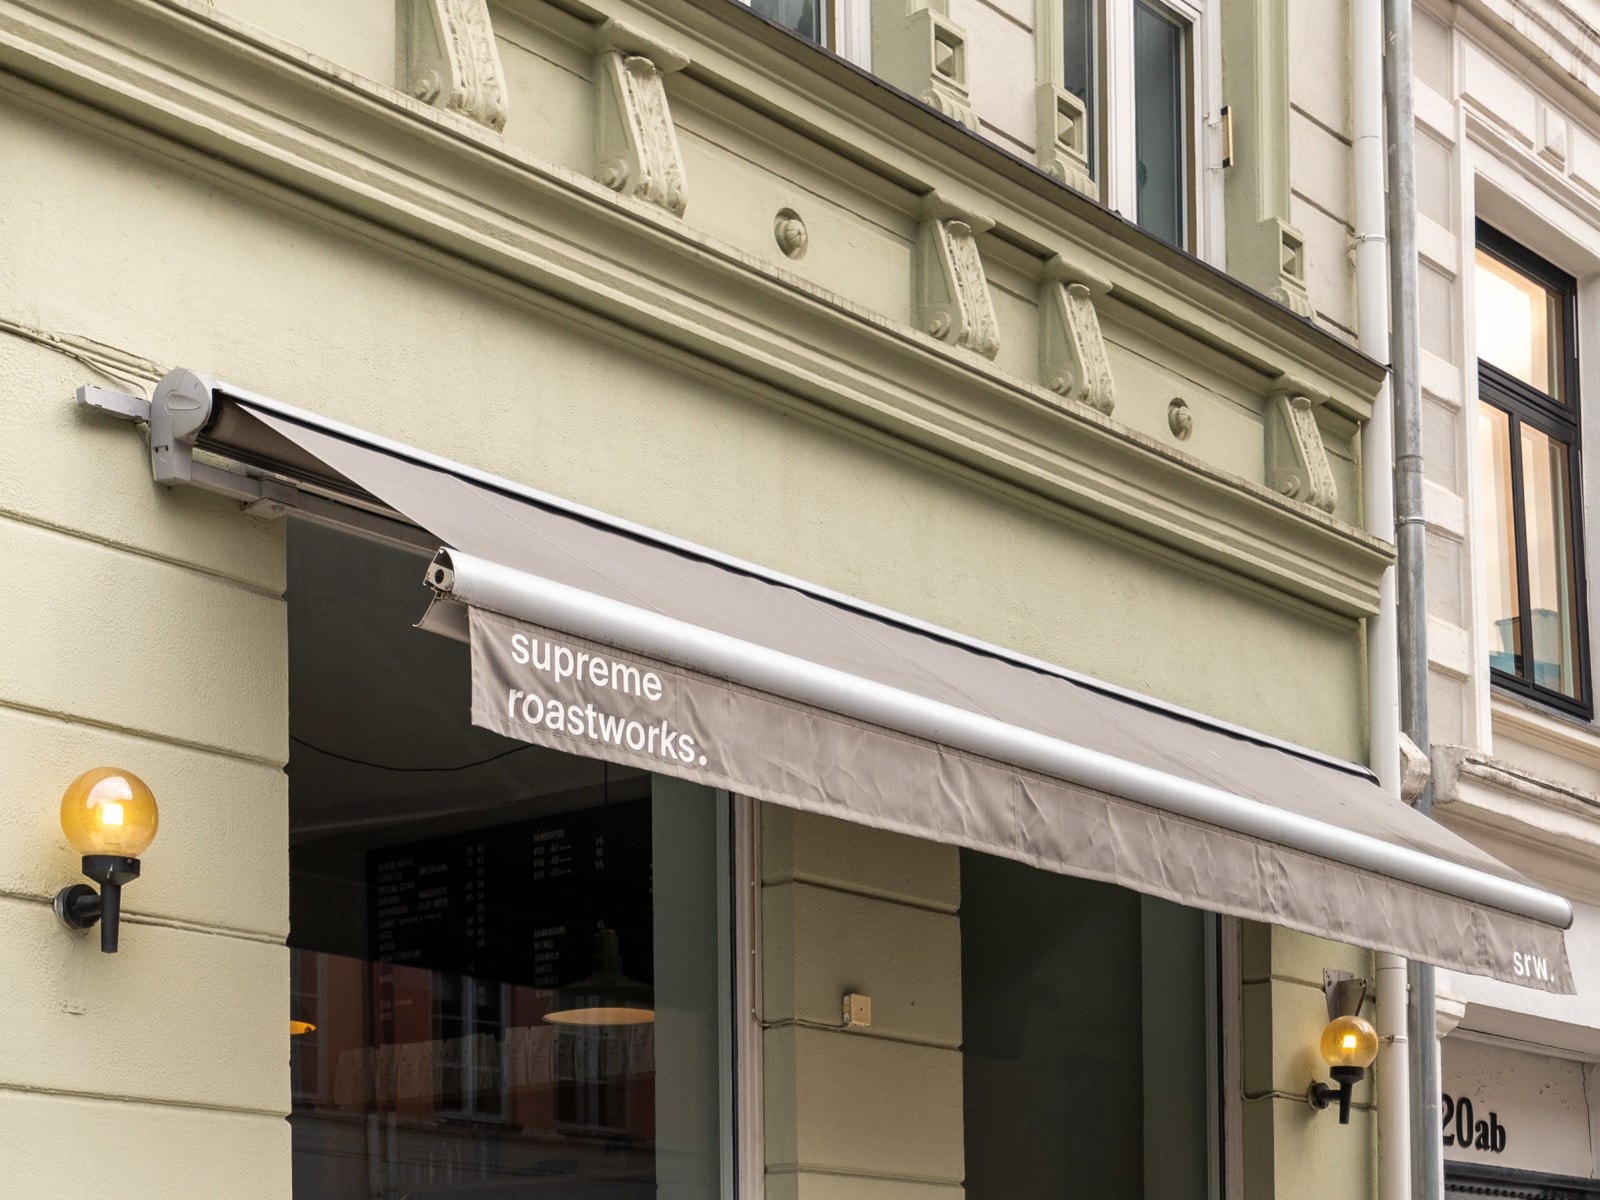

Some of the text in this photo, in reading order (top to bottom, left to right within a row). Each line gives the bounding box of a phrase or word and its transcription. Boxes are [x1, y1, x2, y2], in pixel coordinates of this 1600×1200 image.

[509, 633, 663, 702] supreme
[507, 688, 709, 766] roastworks.
[1513, 950, 1555, 983] srw.
[1442, 1093, 1506, 1154] 20ab
